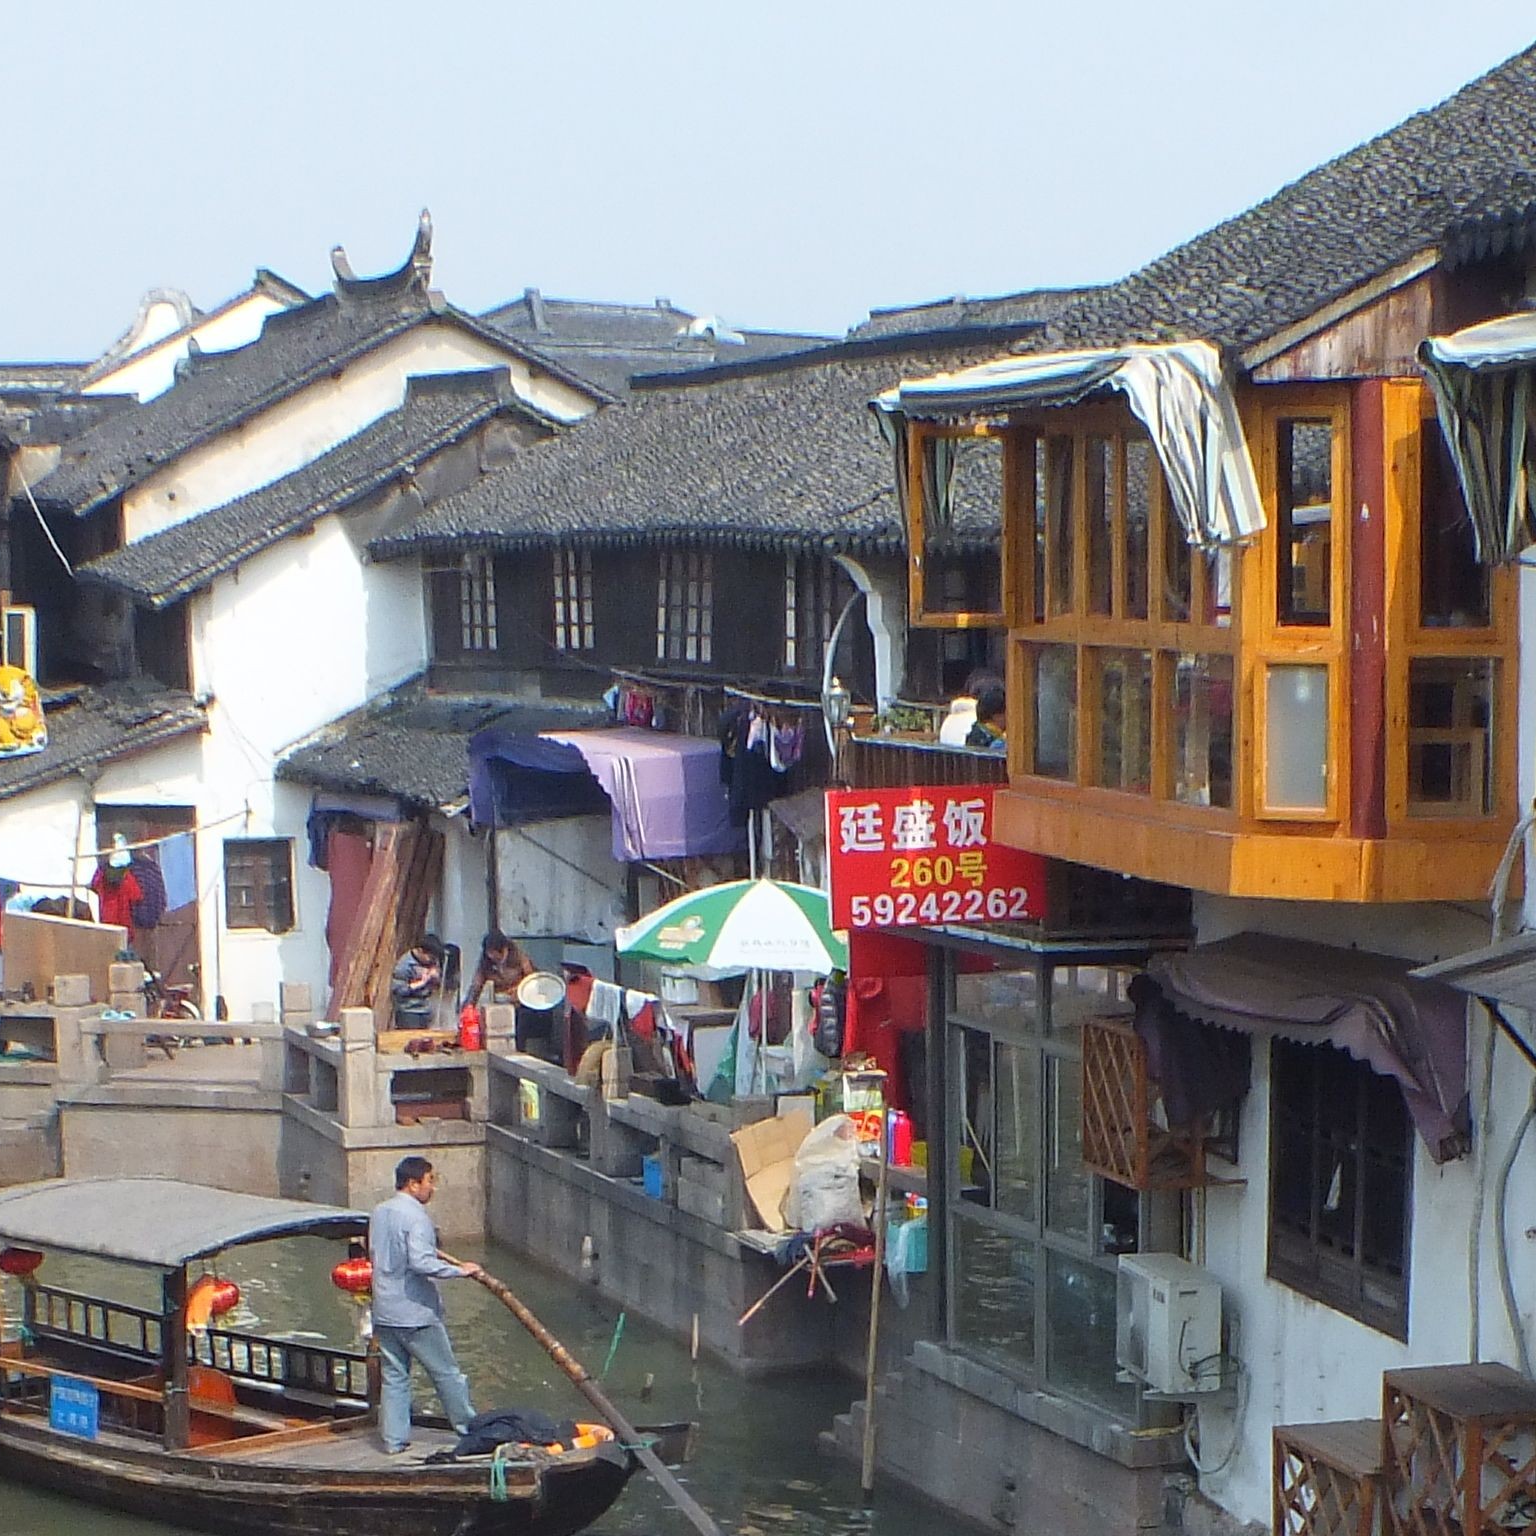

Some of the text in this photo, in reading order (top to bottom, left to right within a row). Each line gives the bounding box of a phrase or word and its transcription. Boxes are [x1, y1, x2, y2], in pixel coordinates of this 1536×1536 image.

[839, 798, 987, 853] 廷盛饭
[891, 851, 988, 888] 260号
[851, 887, 1028, 927] 59242262
